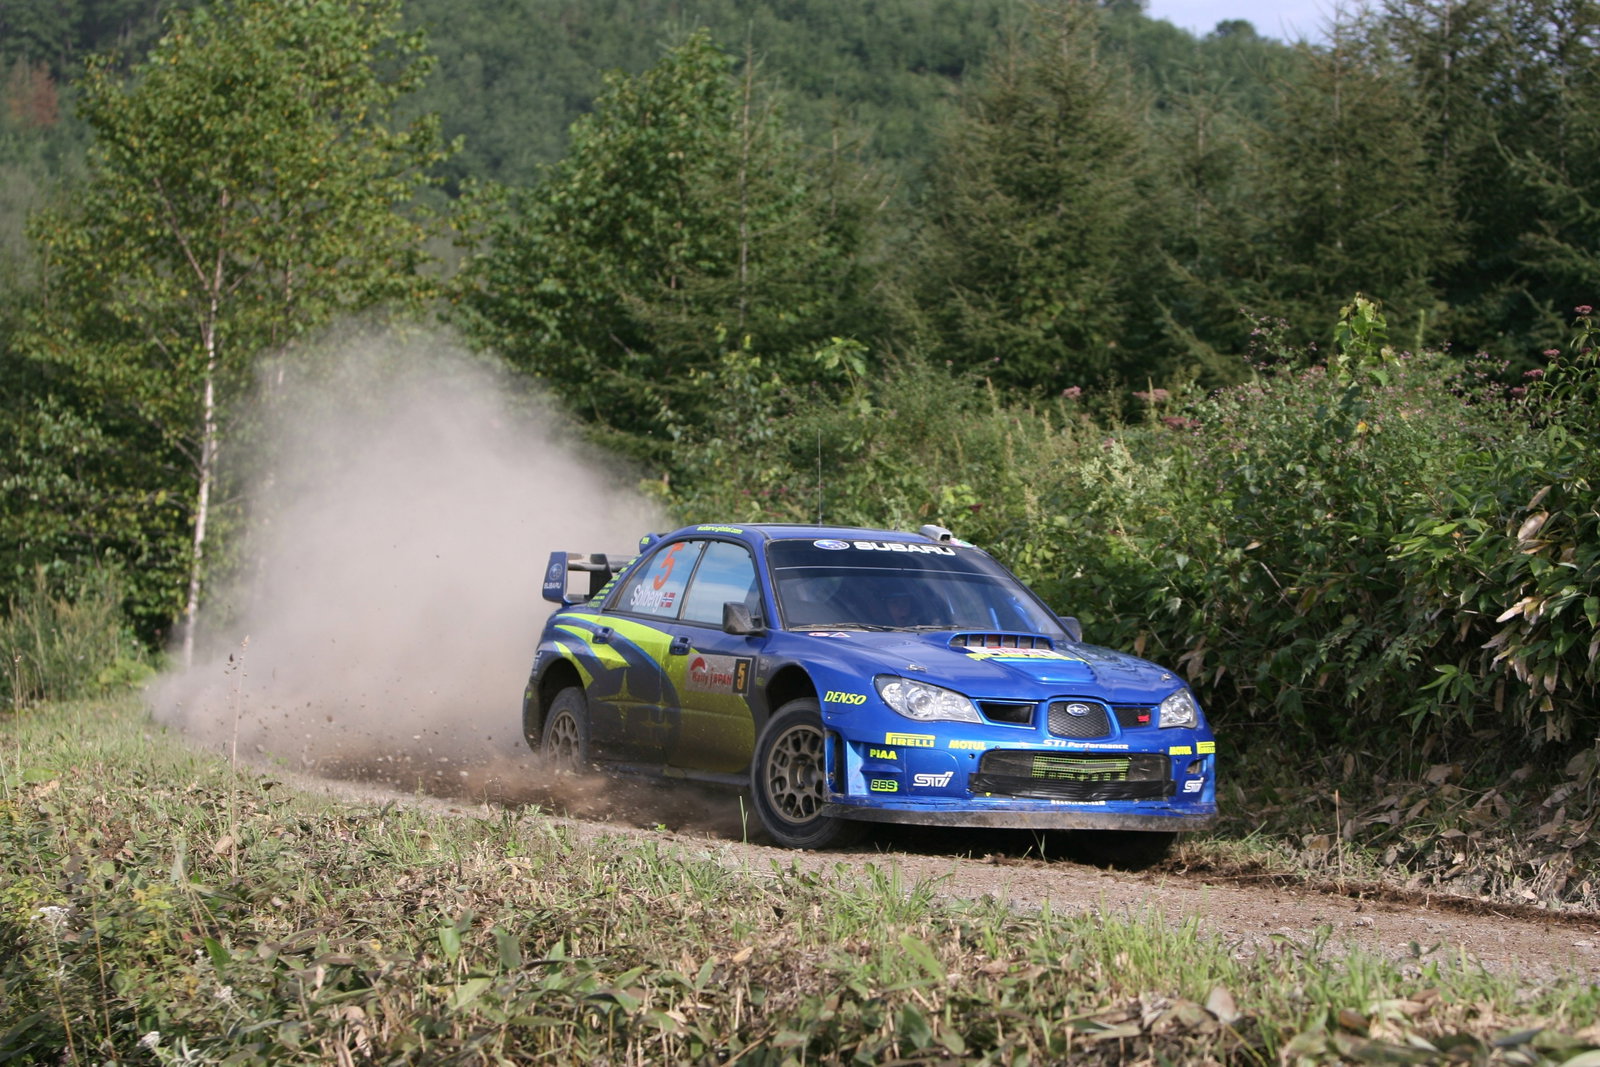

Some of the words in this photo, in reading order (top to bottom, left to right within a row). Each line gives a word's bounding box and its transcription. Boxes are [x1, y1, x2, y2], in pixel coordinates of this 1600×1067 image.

[853, 541, 956, 556] SUBARU
[652, 541, 685, 591] 5
[630, 584, 664, 613] Solberg
[737, 663, 746, 689] 5
[824, 691, 867, 705] DENSO
[885, 732, 936, 747] PIRELLI
[948, 740, 987, 750] MOTUL
[1068, 741, 1129, 750] Performance
[869, 748, 897, 760] PIAA
[871, 779, 898, 791] BBS
